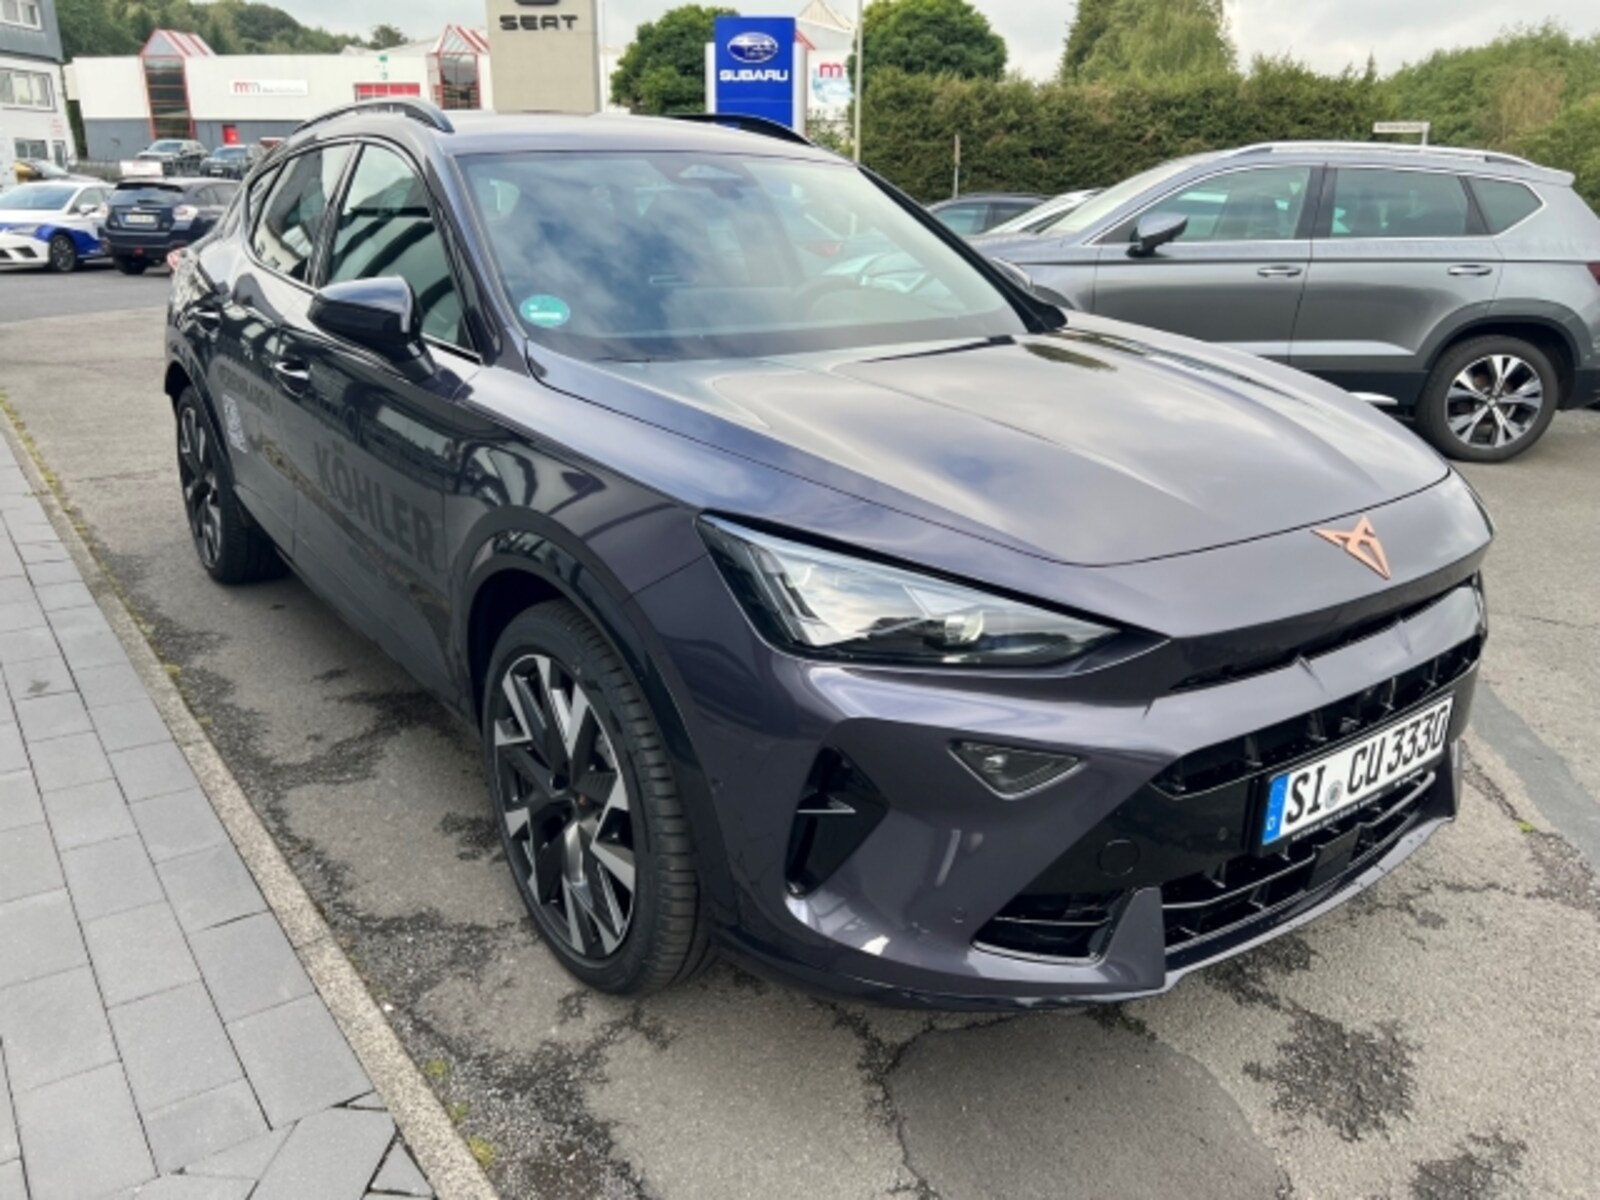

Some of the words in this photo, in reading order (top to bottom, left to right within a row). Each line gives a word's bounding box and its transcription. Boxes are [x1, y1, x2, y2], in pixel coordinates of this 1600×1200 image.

[499, 15, 579, 31] SEAT
[719, 69, 789, 82] SUBARU
[314, 440, 438, 575] KÖHLER
[1285, 765, 1327, 825] SI
[1347, 737, 1386, 795] CU
[1387, 704, 1449, 775] 3330
